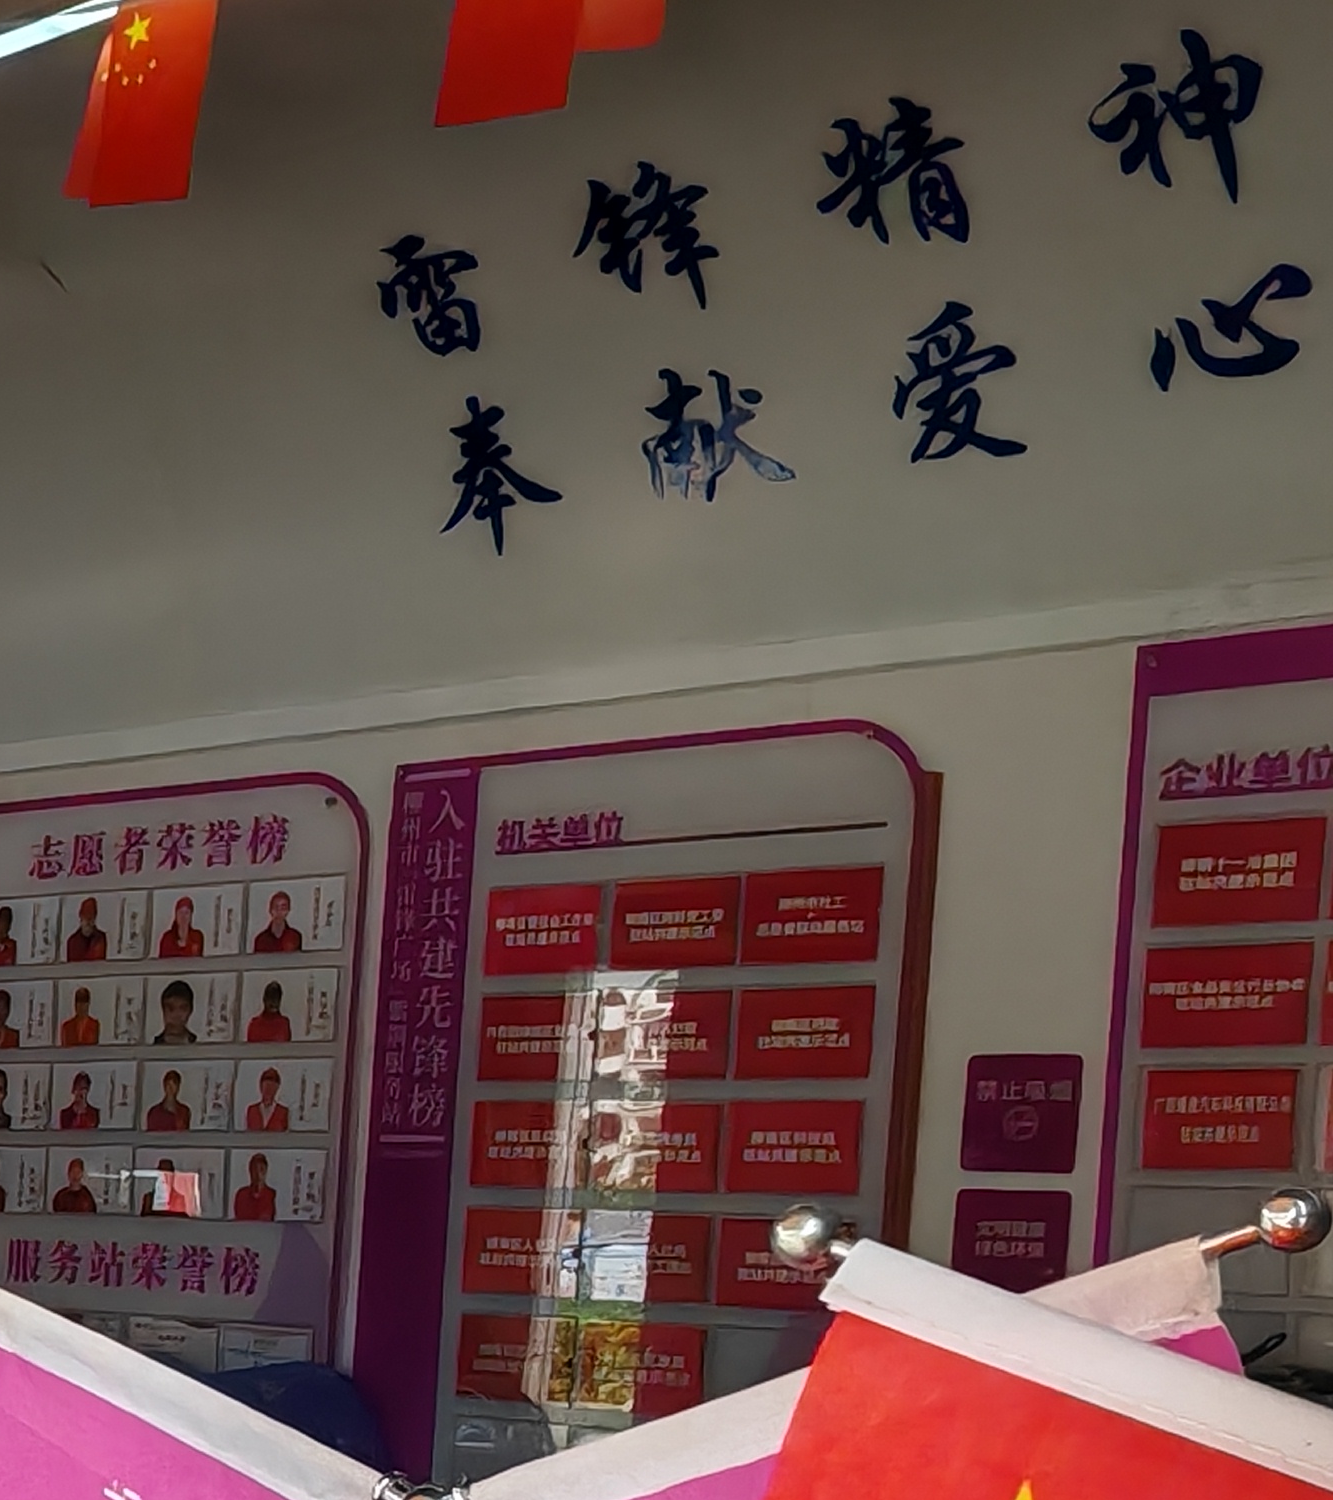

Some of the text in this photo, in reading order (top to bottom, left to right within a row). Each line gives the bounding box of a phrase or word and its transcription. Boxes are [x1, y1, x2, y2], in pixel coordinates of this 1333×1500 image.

[376, 27, 1262, 357] 雷锋精神
[439, 262, 1312, 556] 奉献爱心
[1159, 745, 1333, 799] 企业单位
[28, 812, 290, 880] 志愿者荣誉榜
[497, 811, 624, 852] 机关单位
[408, 788, 466, 1129] 入驻共建先锋榜
[6, 1237, 261, 1296] 服务站荣誉榜
